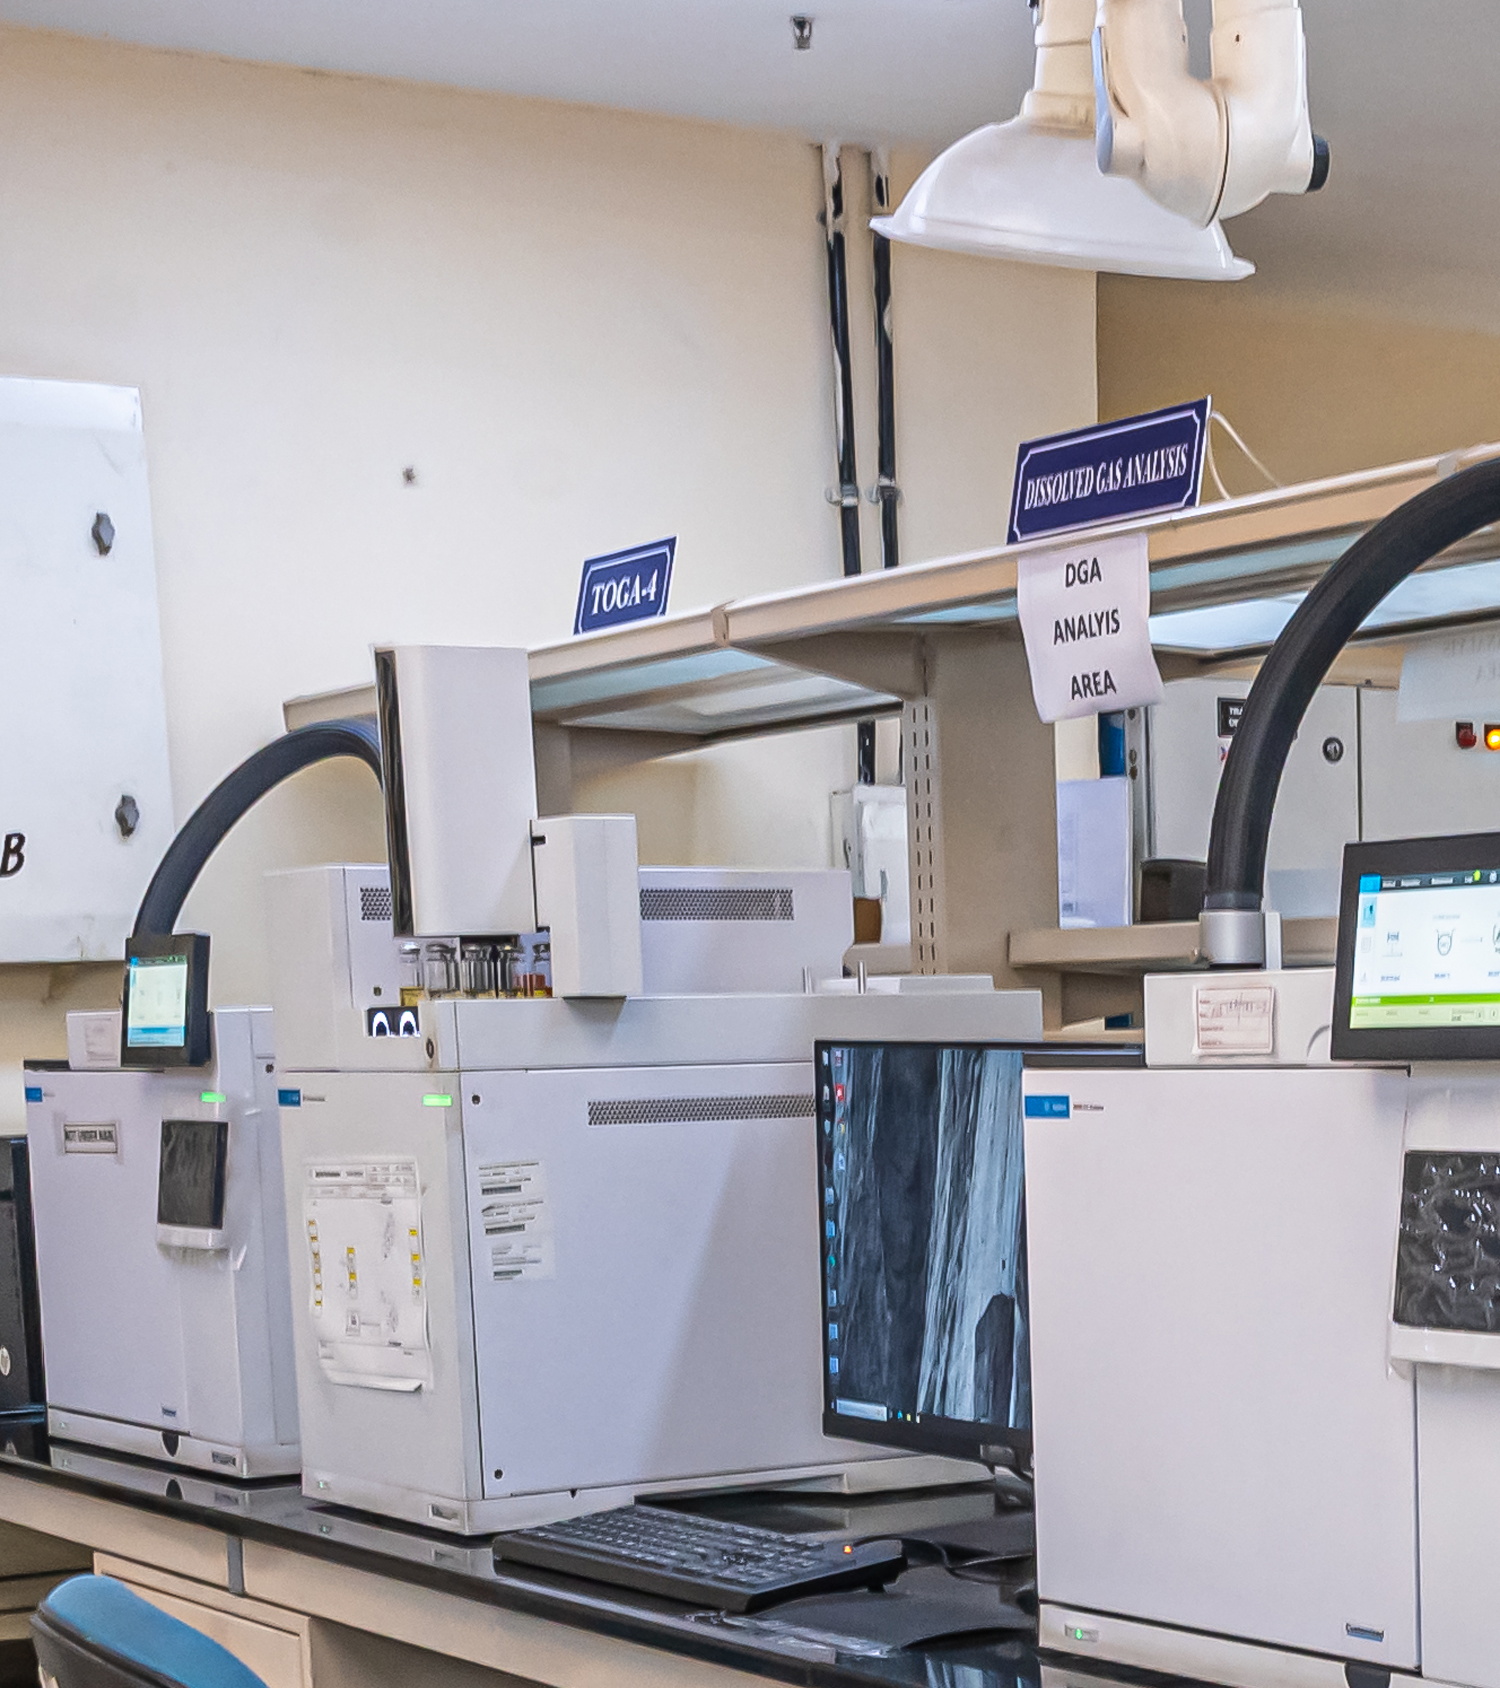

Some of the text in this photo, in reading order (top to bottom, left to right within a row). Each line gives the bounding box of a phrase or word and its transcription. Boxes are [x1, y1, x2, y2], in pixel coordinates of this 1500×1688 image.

[1024, 443, 1189, 511] DISSOLVED GAS ANALYSIS
[1065, 557, 1102, 588] DGA
[591, 568, 658, 616] TOGA-4
[1053, 608, 1121, 646] ANALYIS
[1071, 669, 1117, 701] AREA
